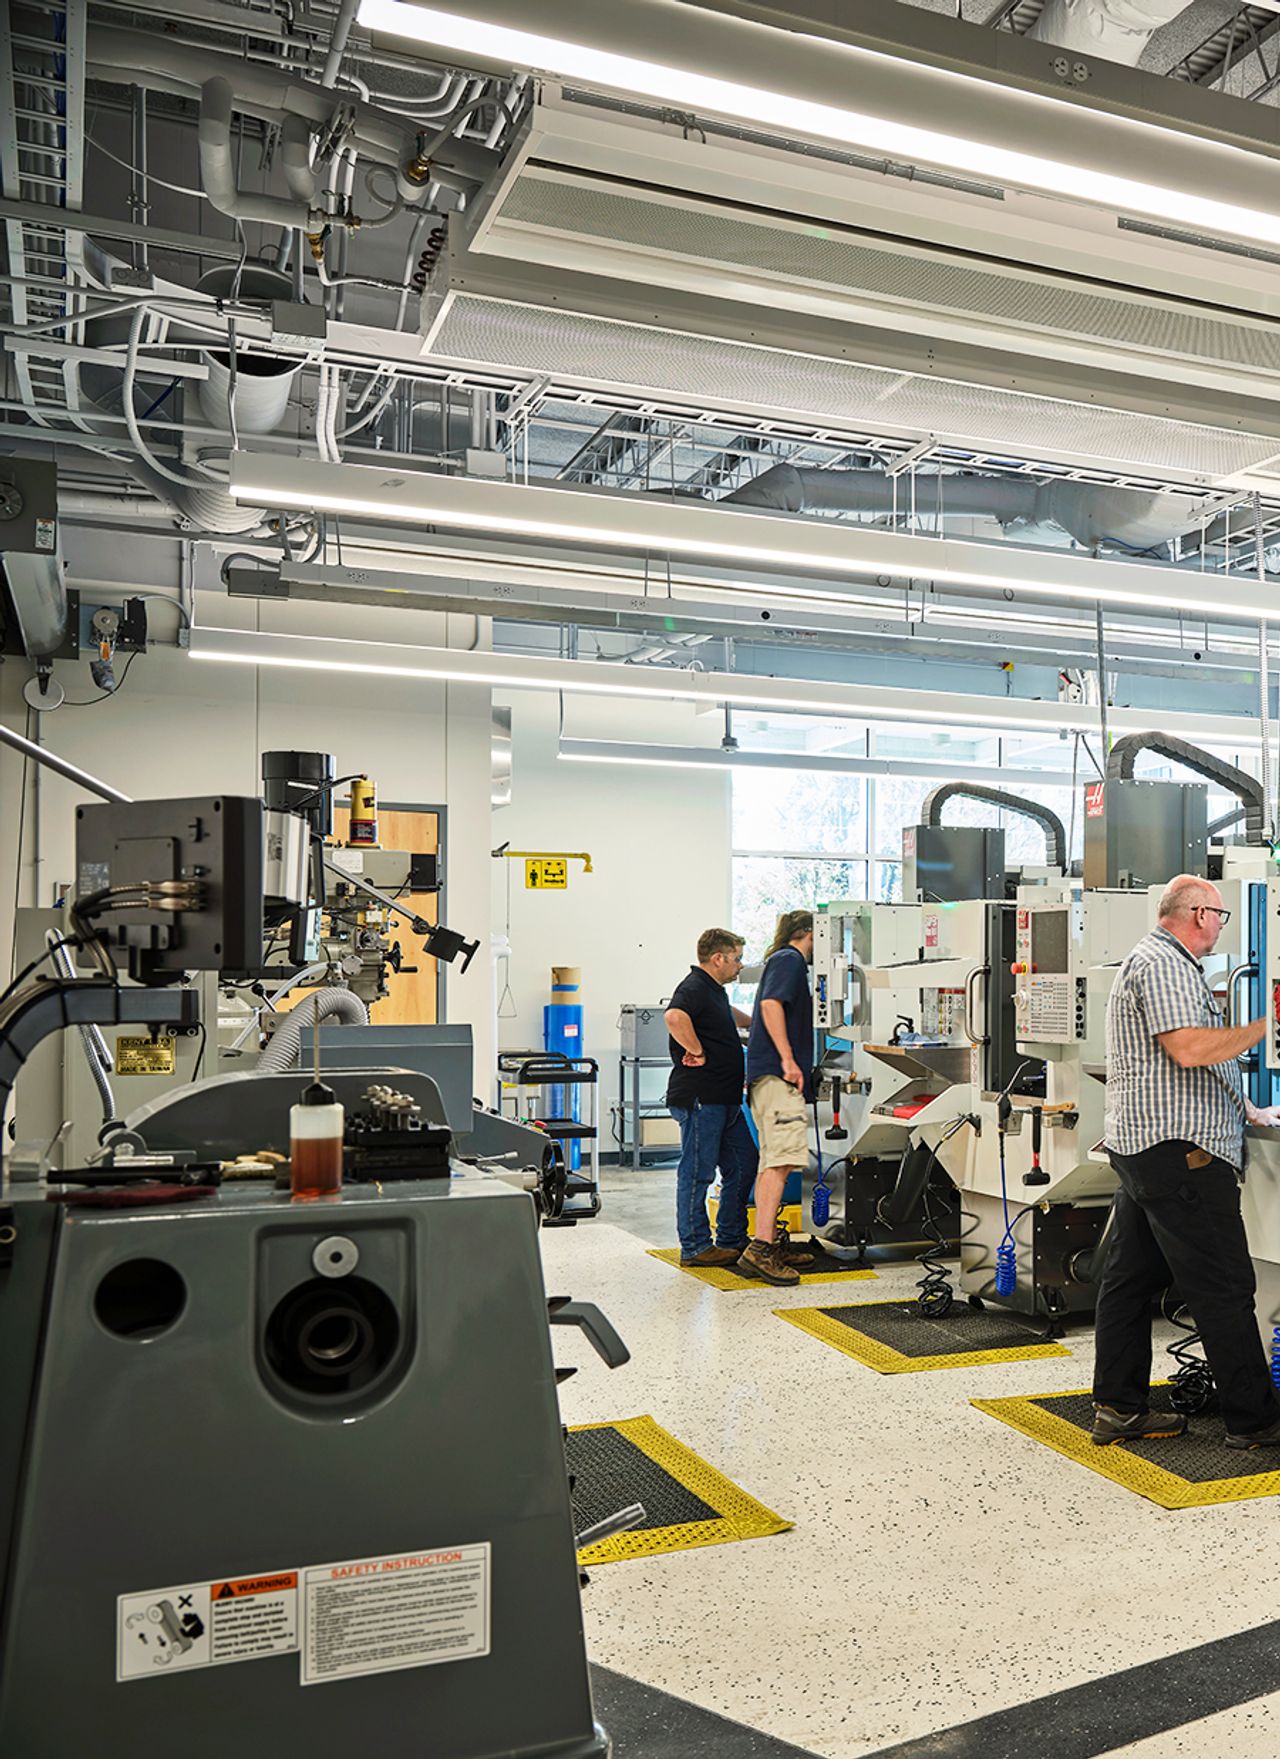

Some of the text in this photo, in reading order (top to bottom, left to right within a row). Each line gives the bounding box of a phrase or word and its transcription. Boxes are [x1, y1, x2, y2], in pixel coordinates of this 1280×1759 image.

[331, 1551, 462, 1579] SAFETY INSTRUCTION
[238, 1577, 292, 1592] WARNING
